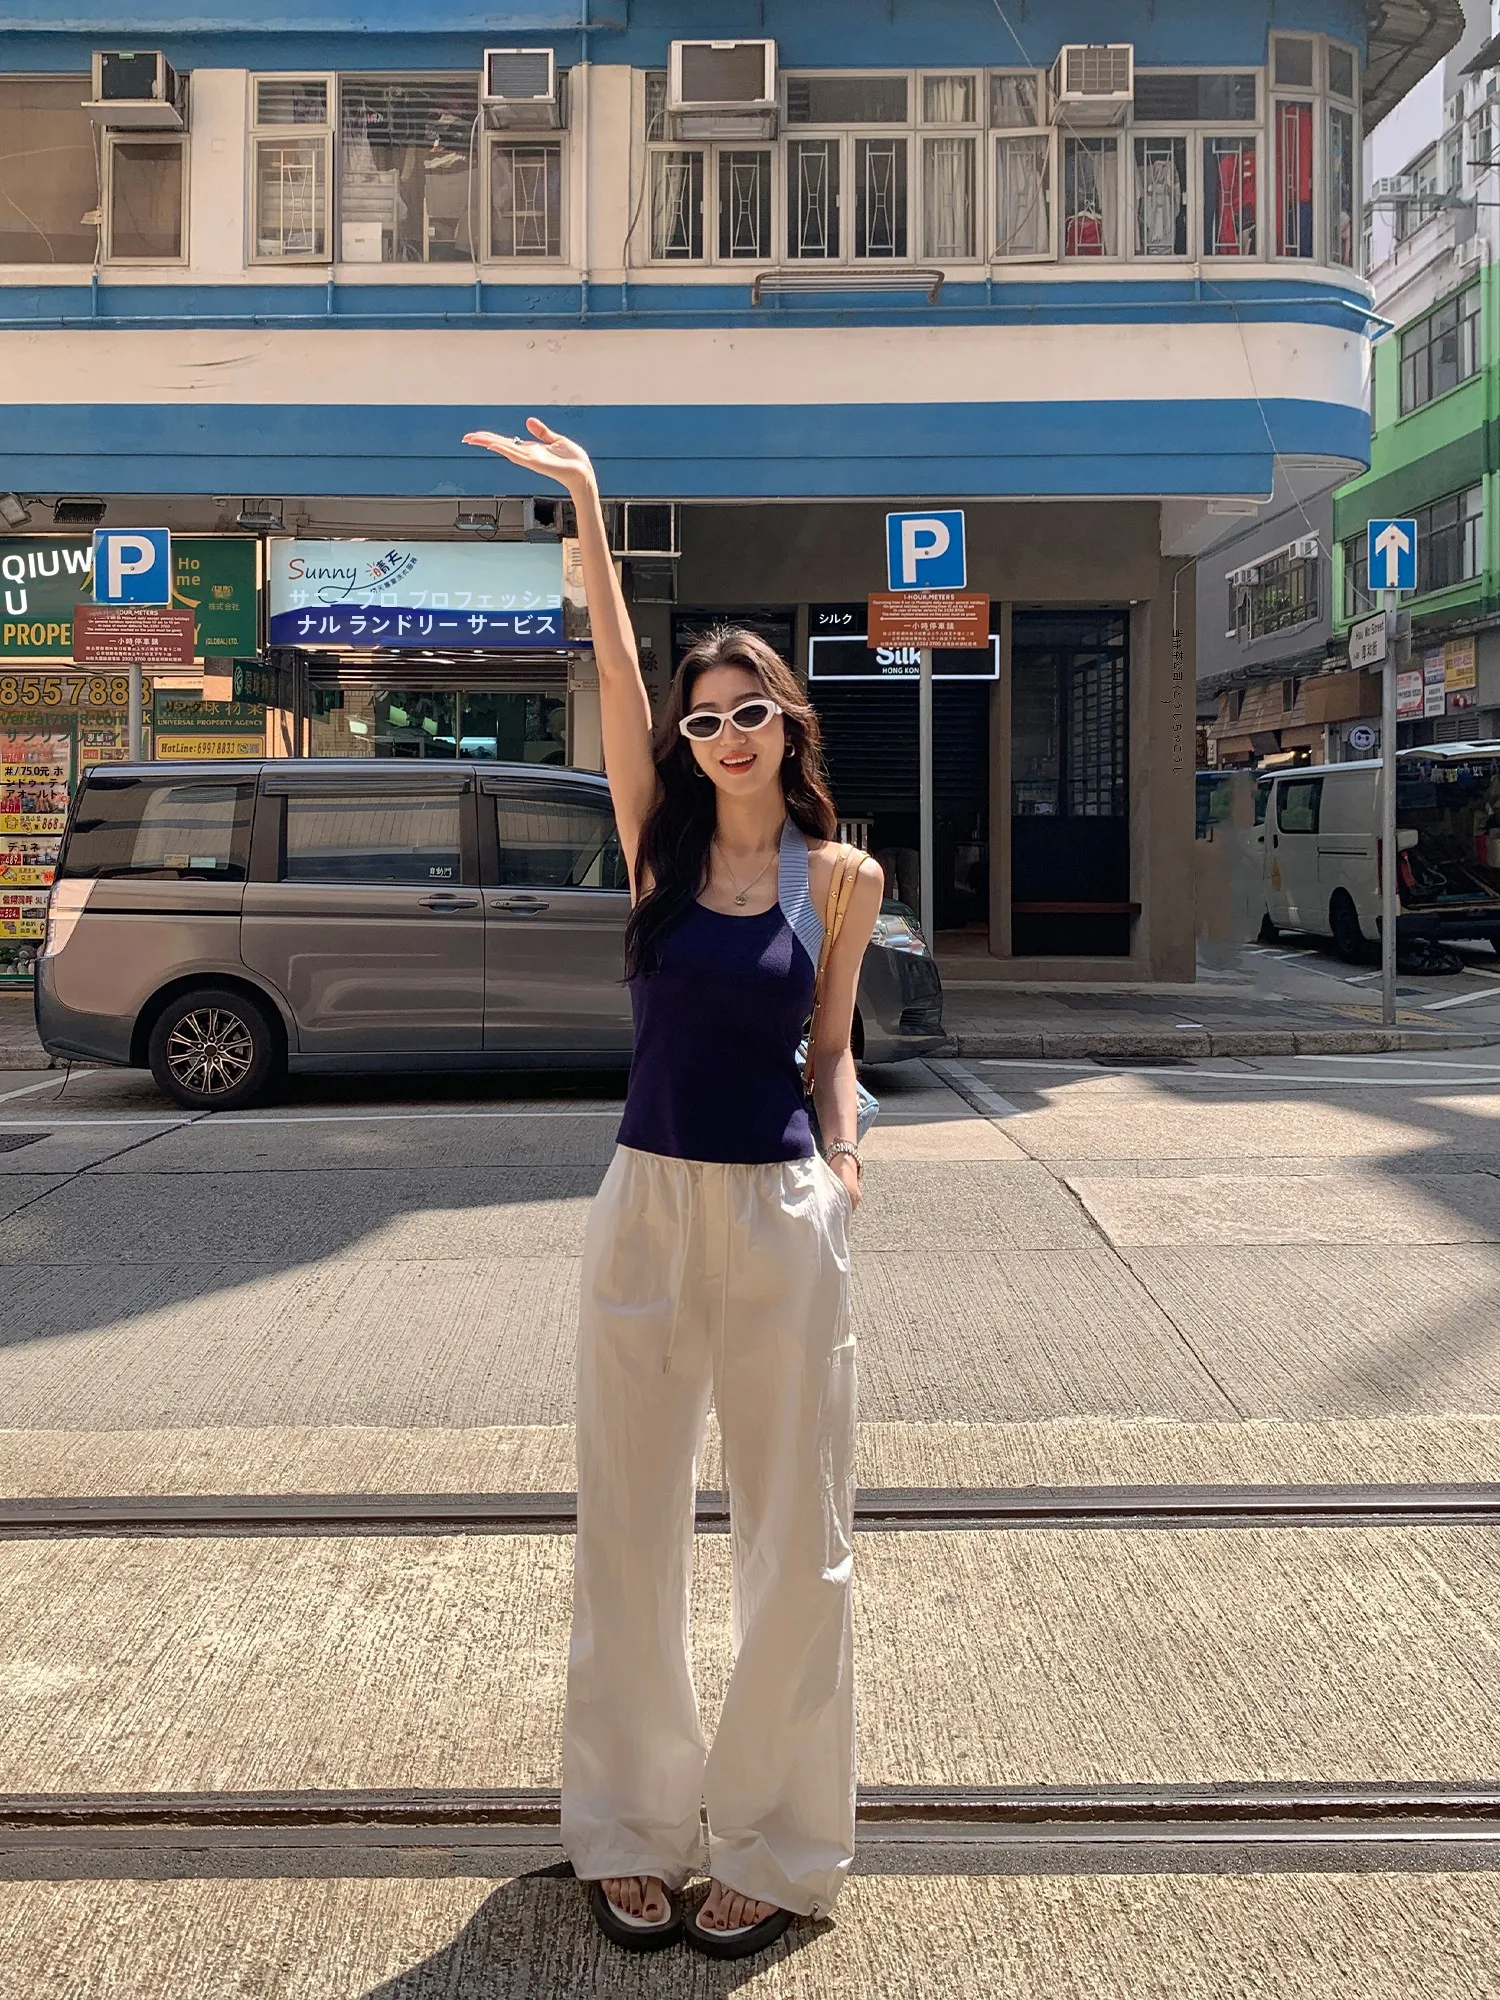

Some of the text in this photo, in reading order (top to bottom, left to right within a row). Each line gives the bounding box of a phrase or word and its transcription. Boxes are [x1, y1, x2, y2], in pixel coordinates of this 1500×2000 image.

[902, 519, 950, 583] P
[108, 535, 155, 598] P
[178, 557, 200, 570] Ho
[176, 575, 201, 586] me
[288, 558, 356, 592] Sunny
[297, 614, 556, 636] ナル ランドリー サービス
[819, 613, 852, 624] シルク
[3, 623, 74, 646] PROPE
[876, 647, 921, 666] Silk
[882, 667, 920, 675] HONG KON
[143, 711, 151, 724] k
[161, 741, 197, 753] HotLine:
[42, 817, 58, 830] 868
